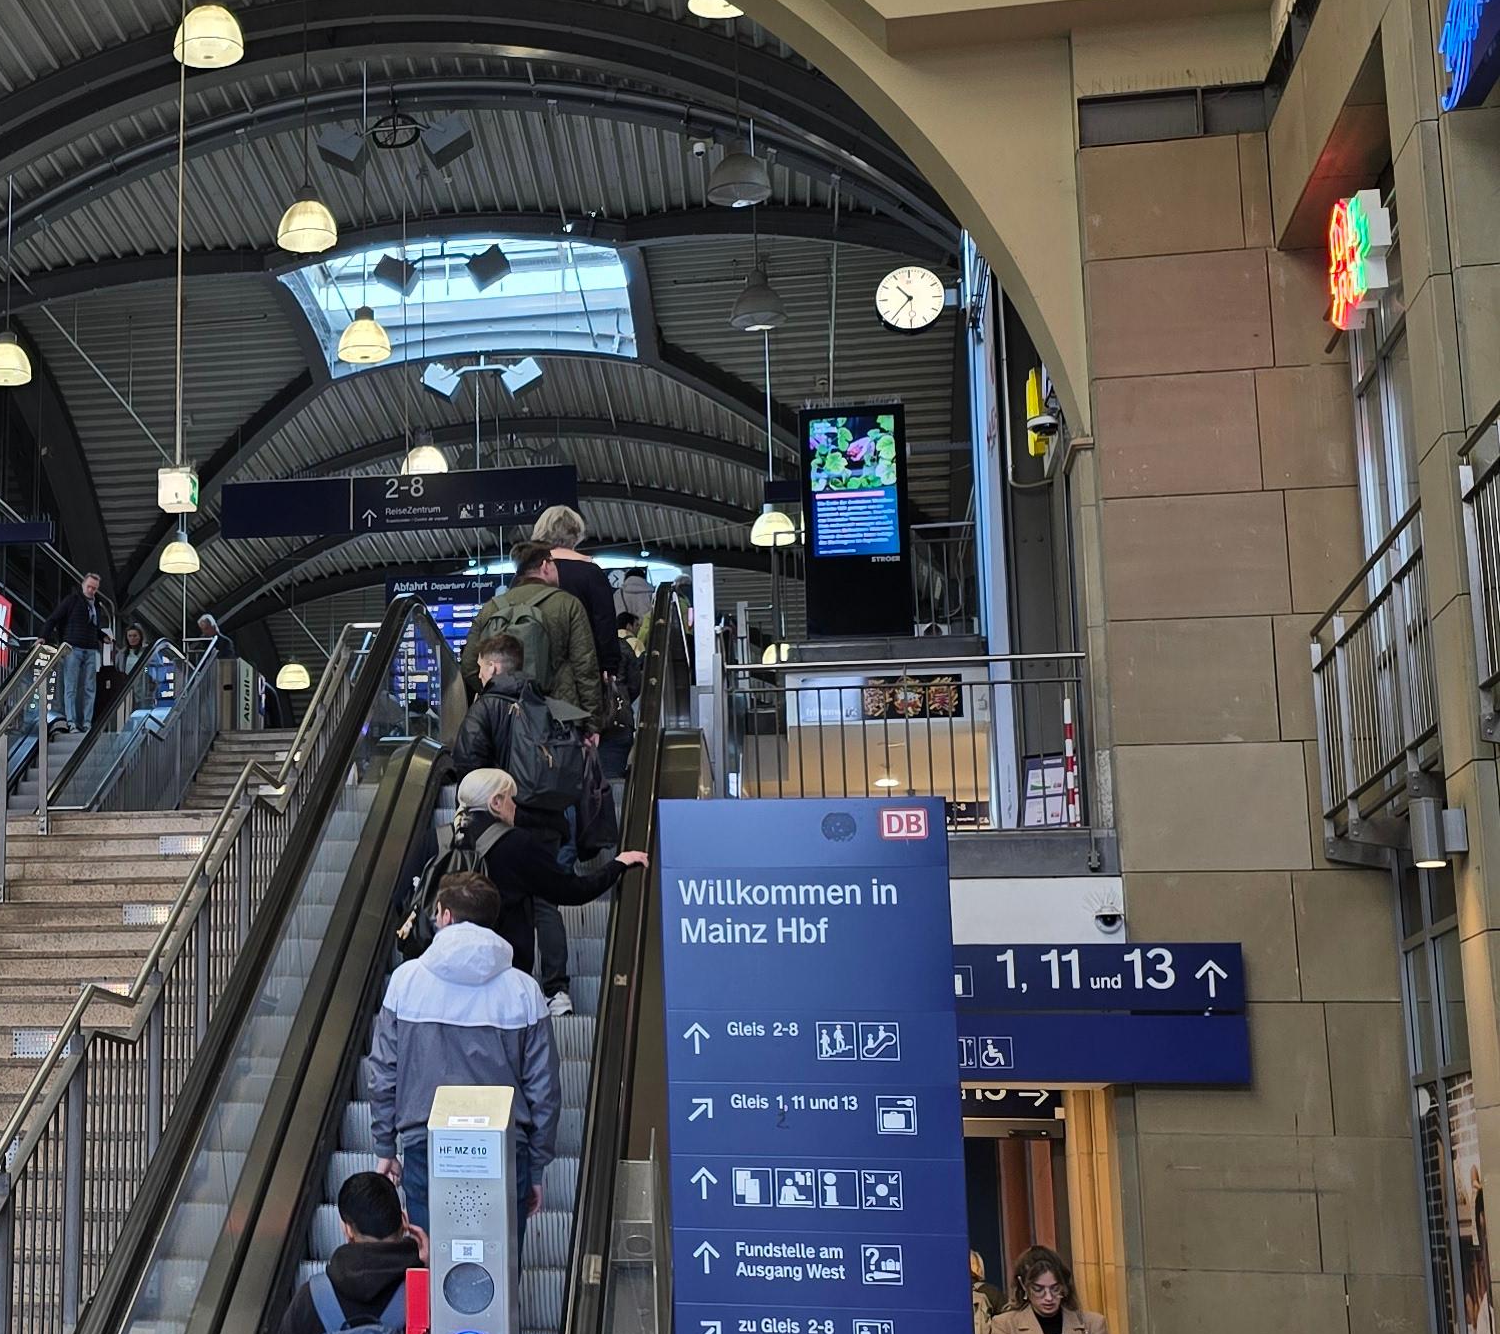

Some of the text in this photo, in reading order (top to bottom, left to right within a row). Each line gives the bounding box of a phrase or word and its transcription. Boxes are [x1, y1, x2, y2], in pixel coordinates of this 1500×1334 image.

[385, 477, 424, 499] 2-8
[385, 505, 441, 516] ReiseZentrum
[393, 581, 428, 592] Abfahrt
[431, 581, 465, 590] Departure
[243, 679, 251, 722] Abfall
[884, 812, 925, 836] DB
[678, 878, 899, 906] Willkommen in
[680, 916, 830, 945] Mainz Hbf
[996, 947, 1176, 994] 1, 11 und 13
[726, 1020, 799, 1038] Gleis 2-8
[730, 1093, 859, 1113] Gleis 1, 11 und 13
[439, 1146, 487, 1156] HF MZ 610
[735, 1240, 844, 1261] Fundstelle am
[736, 1261, 846, 1282] Ausgang West
[738, 1319, 757, 1334] zu
[761, 1317, 801, 1334] Gleis
